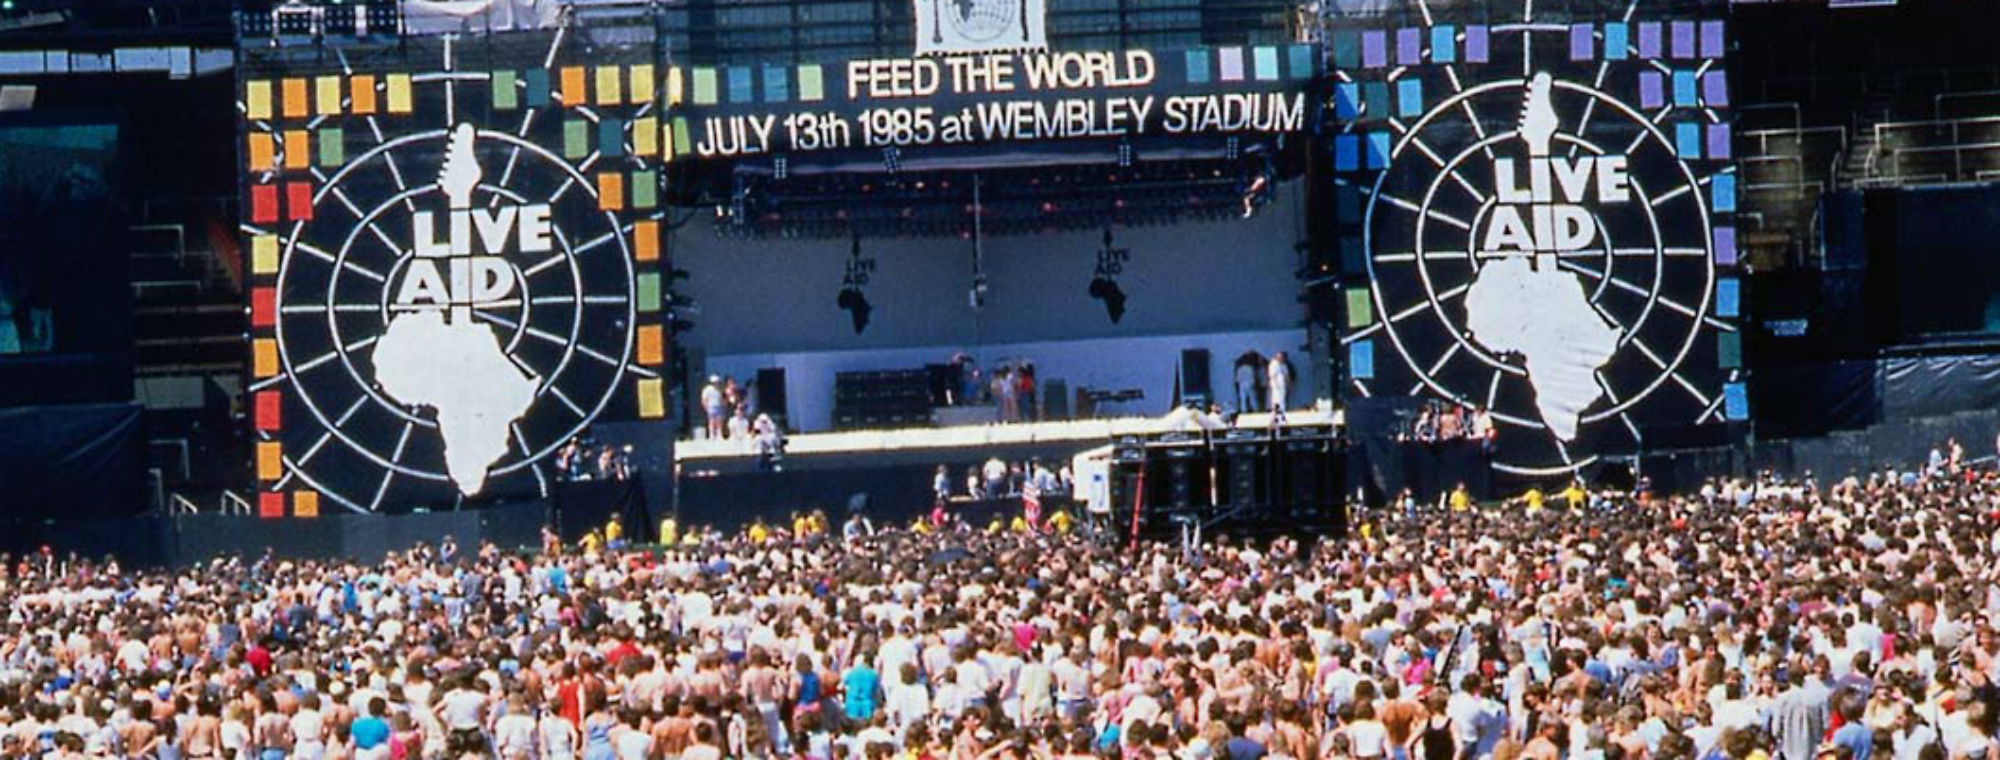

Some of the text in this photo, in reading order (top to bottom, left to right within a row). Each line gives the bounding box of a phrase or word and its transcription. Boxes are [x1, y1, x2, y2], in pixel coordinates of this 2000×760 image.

[848, 50, 1155, 98] FEED THE WORLD
[697, 93, 1305, 156] JULY 13th 1985 at WEMBLEY STADIUM
[1495, 155, 1630, 203] LIVE
[413, 203, 552, 258] LIVE
[1484, 204, 1596, 252] AID
[1097, 248, 1130, 263] LIVE
[396, 256, 515, 305] AID
